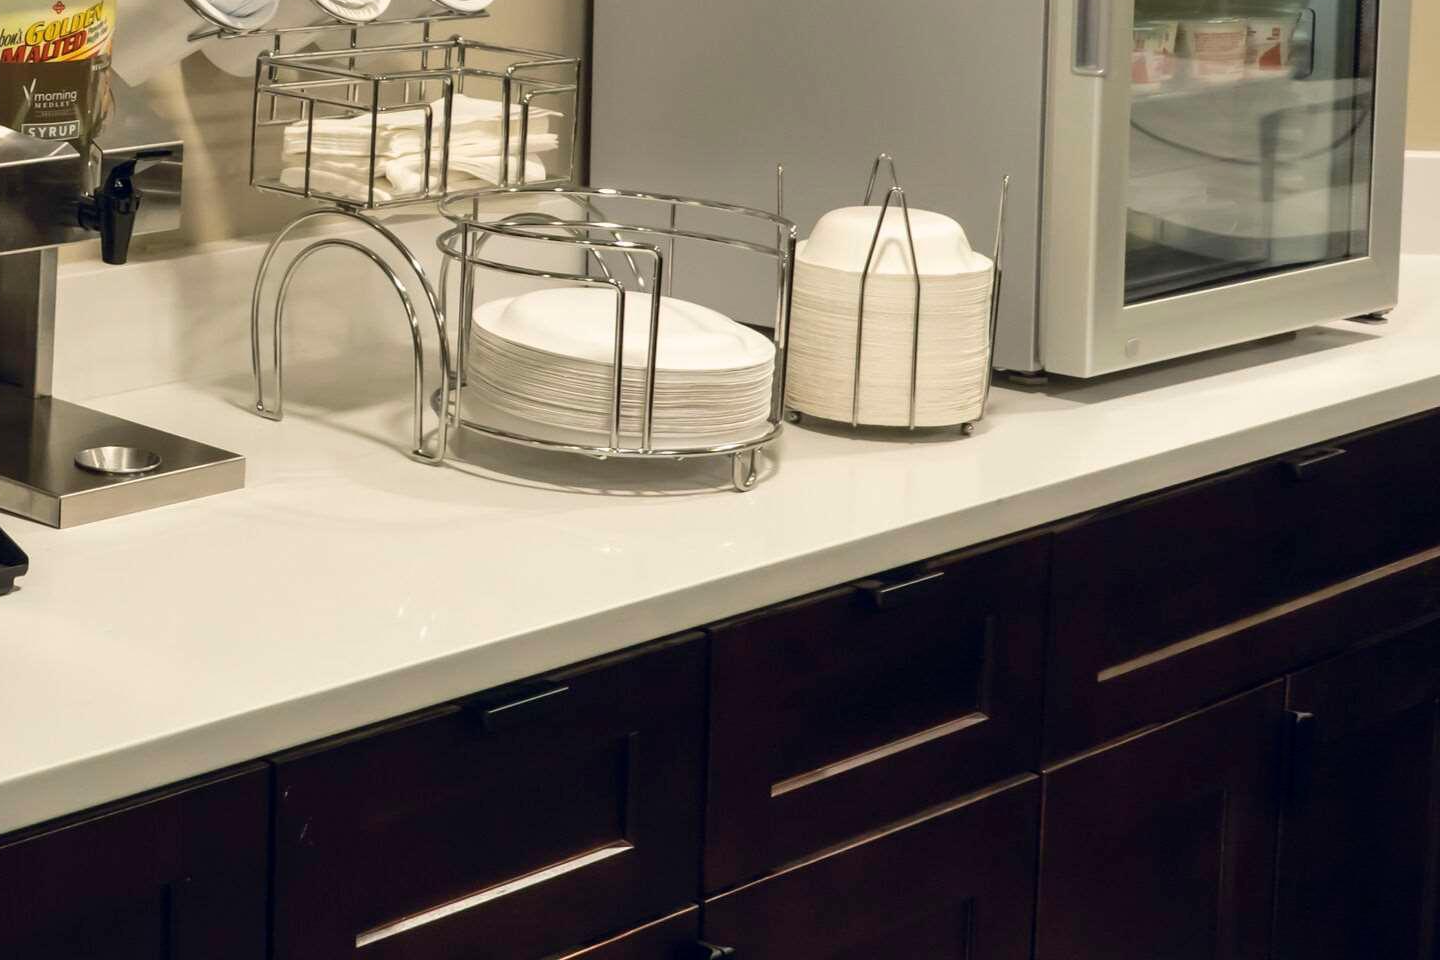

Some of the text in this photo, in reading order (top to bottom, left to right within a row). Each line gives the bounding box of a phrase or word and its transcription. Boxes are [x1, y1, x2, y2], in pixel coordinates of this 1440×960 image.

[0, 30, 89, 64] MALTED
[34, 90, 78, 102] morning
[28, 124, 77, 138] SYRUP
